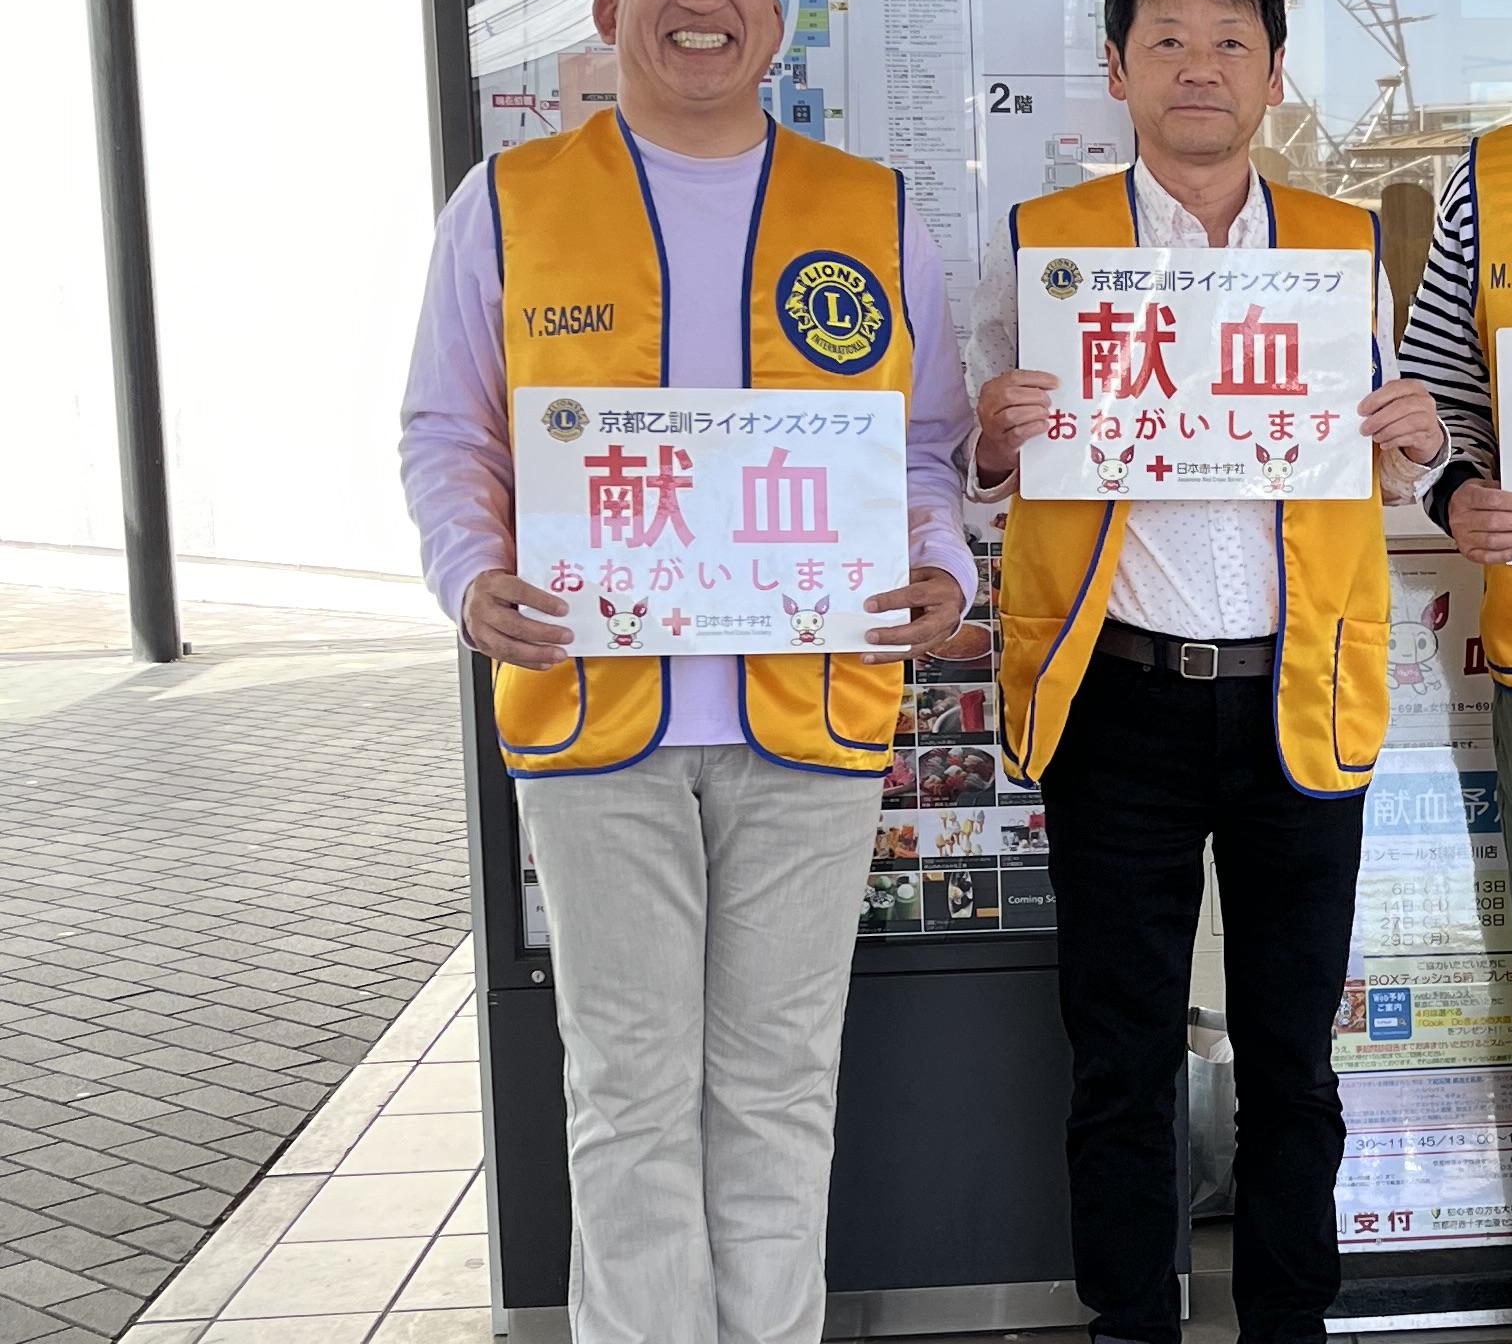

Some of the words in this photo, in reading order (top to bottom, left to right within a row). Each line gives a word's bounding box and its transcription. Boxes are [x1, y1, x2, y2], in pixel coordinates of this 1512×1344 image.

[989, 82, 1033, 115] 2階
[804, 264, 863, 290] LIONS
[1091, 268, 1344, 294] 京都乙訓ライオンズクラブ
[523, 304, 615, 339] Y.SASAKI
[824, 291, 852, 328] L
[1077, 301, 1309, 400] 献血
[598, 409, 875, 436] 京都乙訓ライオンズクラブ
[1047, 408, 1341, 442] おねがいします
[1176, 462, 1246, 475] 日本赤十字社
[584, 444, 839, 550] 献血
[549, 557, 875, 594] おねがいします
[695, 614, 772, 628] 日本赤十字社
[1008, 895, 1044, 906] Coming
[1353, 1210, 1414, 1234] 受付
